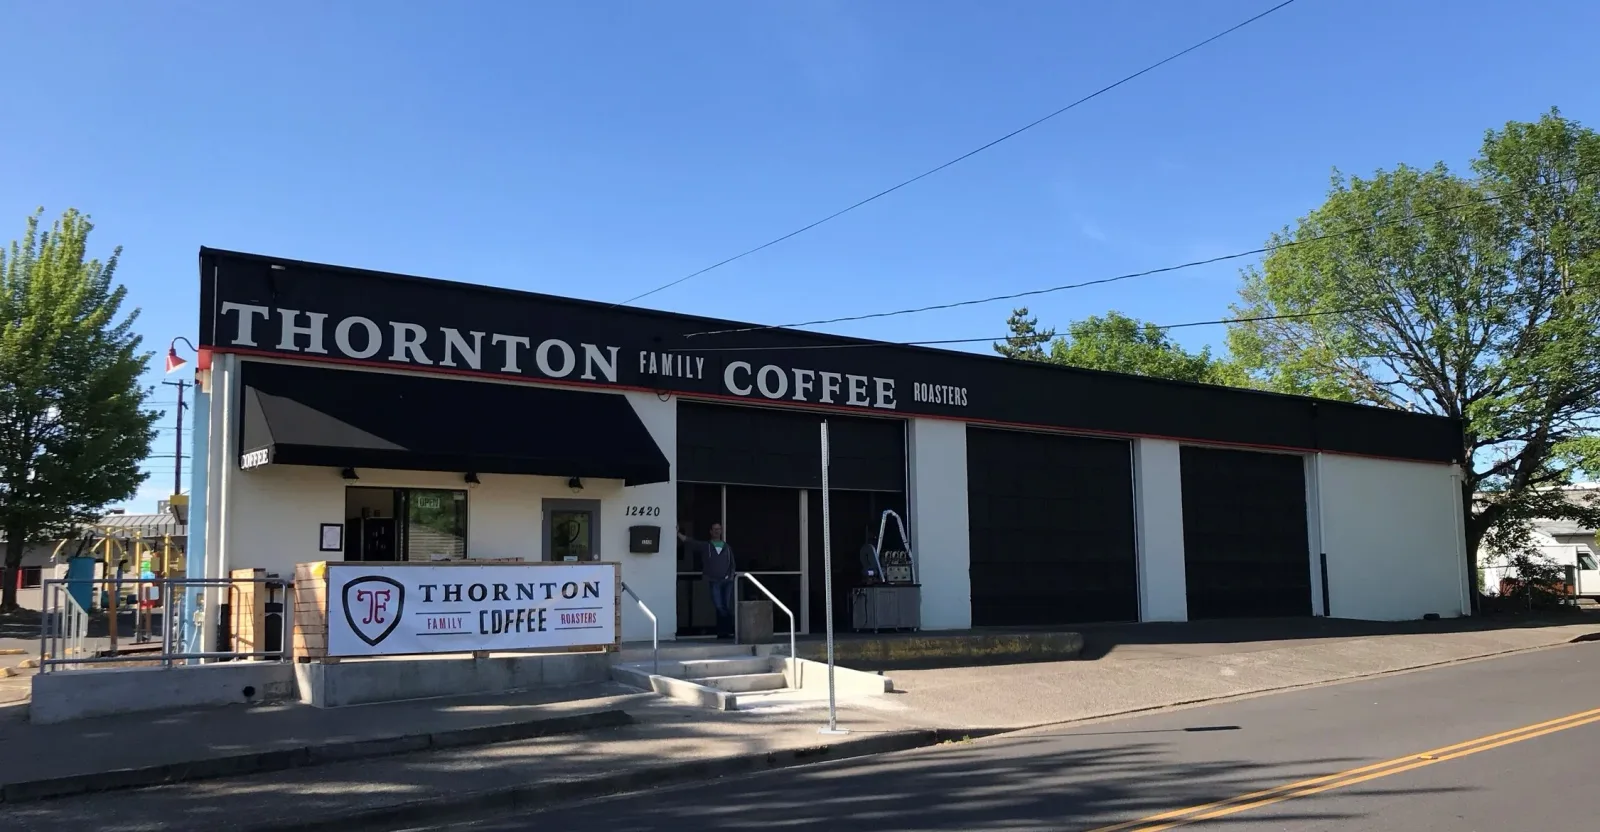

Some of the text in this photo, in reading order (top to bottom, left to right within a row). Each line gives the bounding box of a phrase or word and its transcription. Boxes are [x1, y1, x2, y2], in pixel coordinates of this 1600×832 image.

[221, 301, 968, 409] THORNTON FAMILY COFFEE ROASTERS
[625, 505, 660, 517] 12420
[418, 581, 600, 602] THORNTON
[427, 608, 597, 634] FAMILY COFFEE ROASTERS
